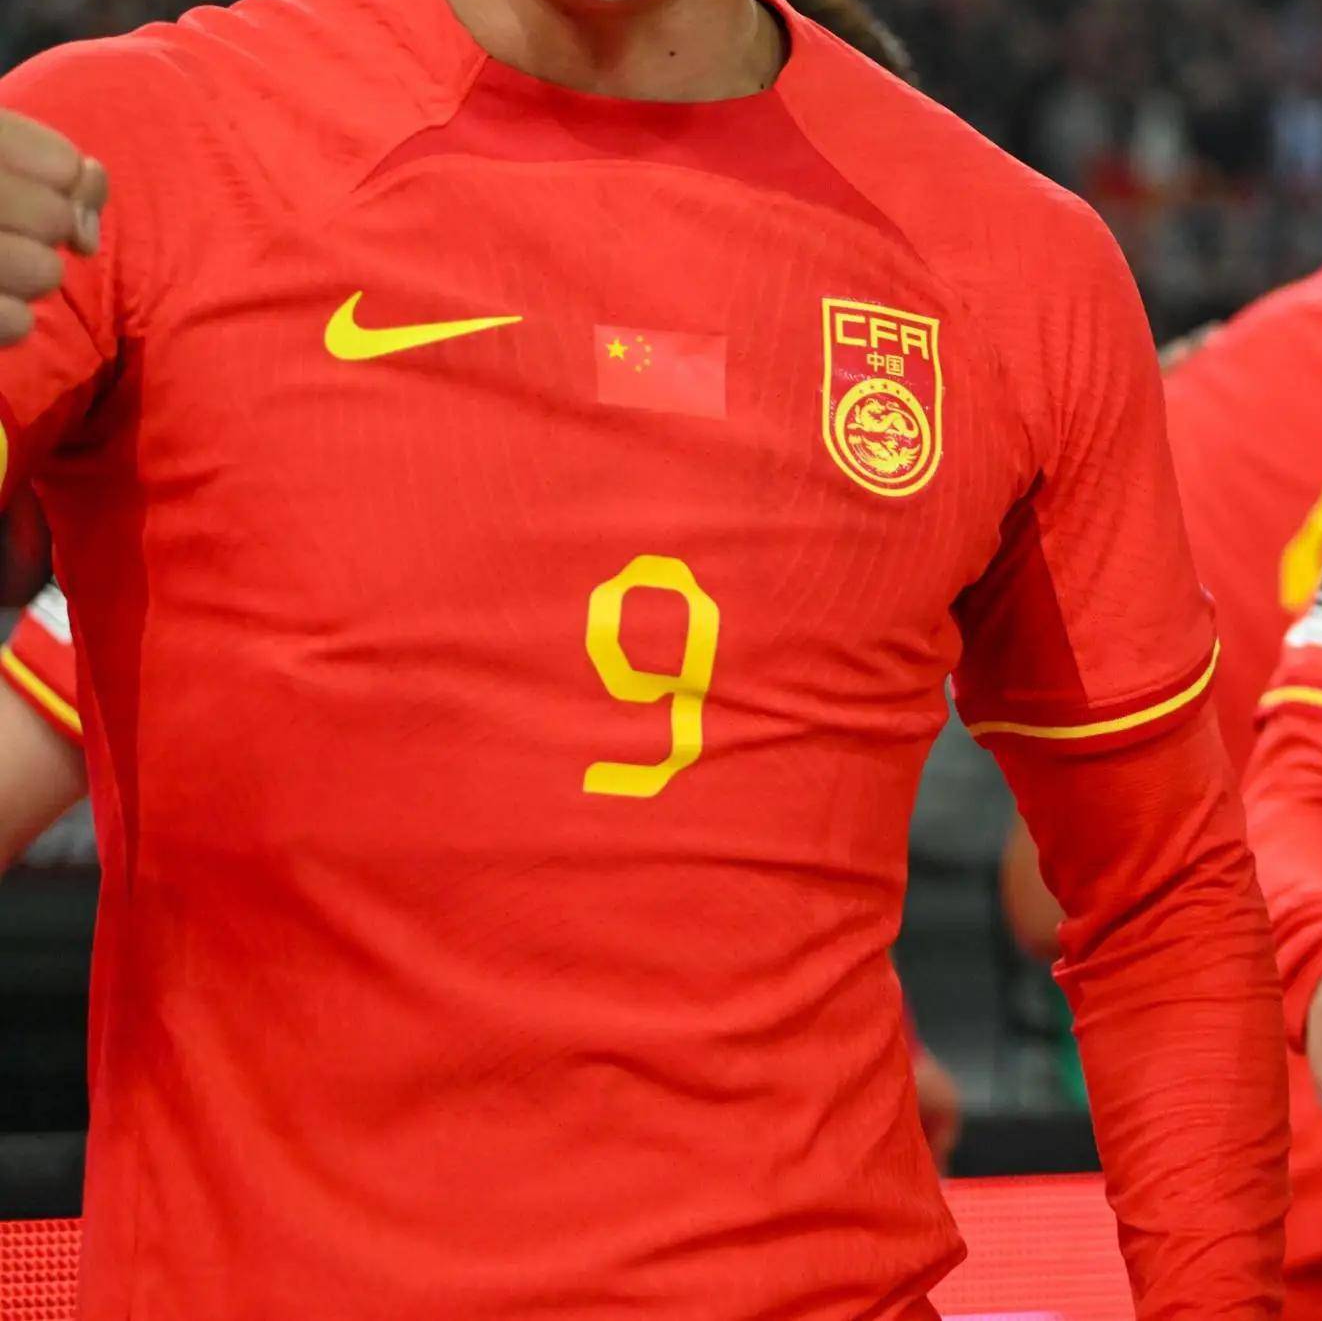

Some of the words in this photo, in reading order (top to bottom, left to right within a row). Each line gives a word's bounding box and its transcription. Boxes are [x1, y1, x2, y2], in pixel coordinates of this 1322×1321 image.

[835, 312, 930, 360] CFA
[866, 351, 904, 377] 中国
[583, 554, 720, 798] 9
